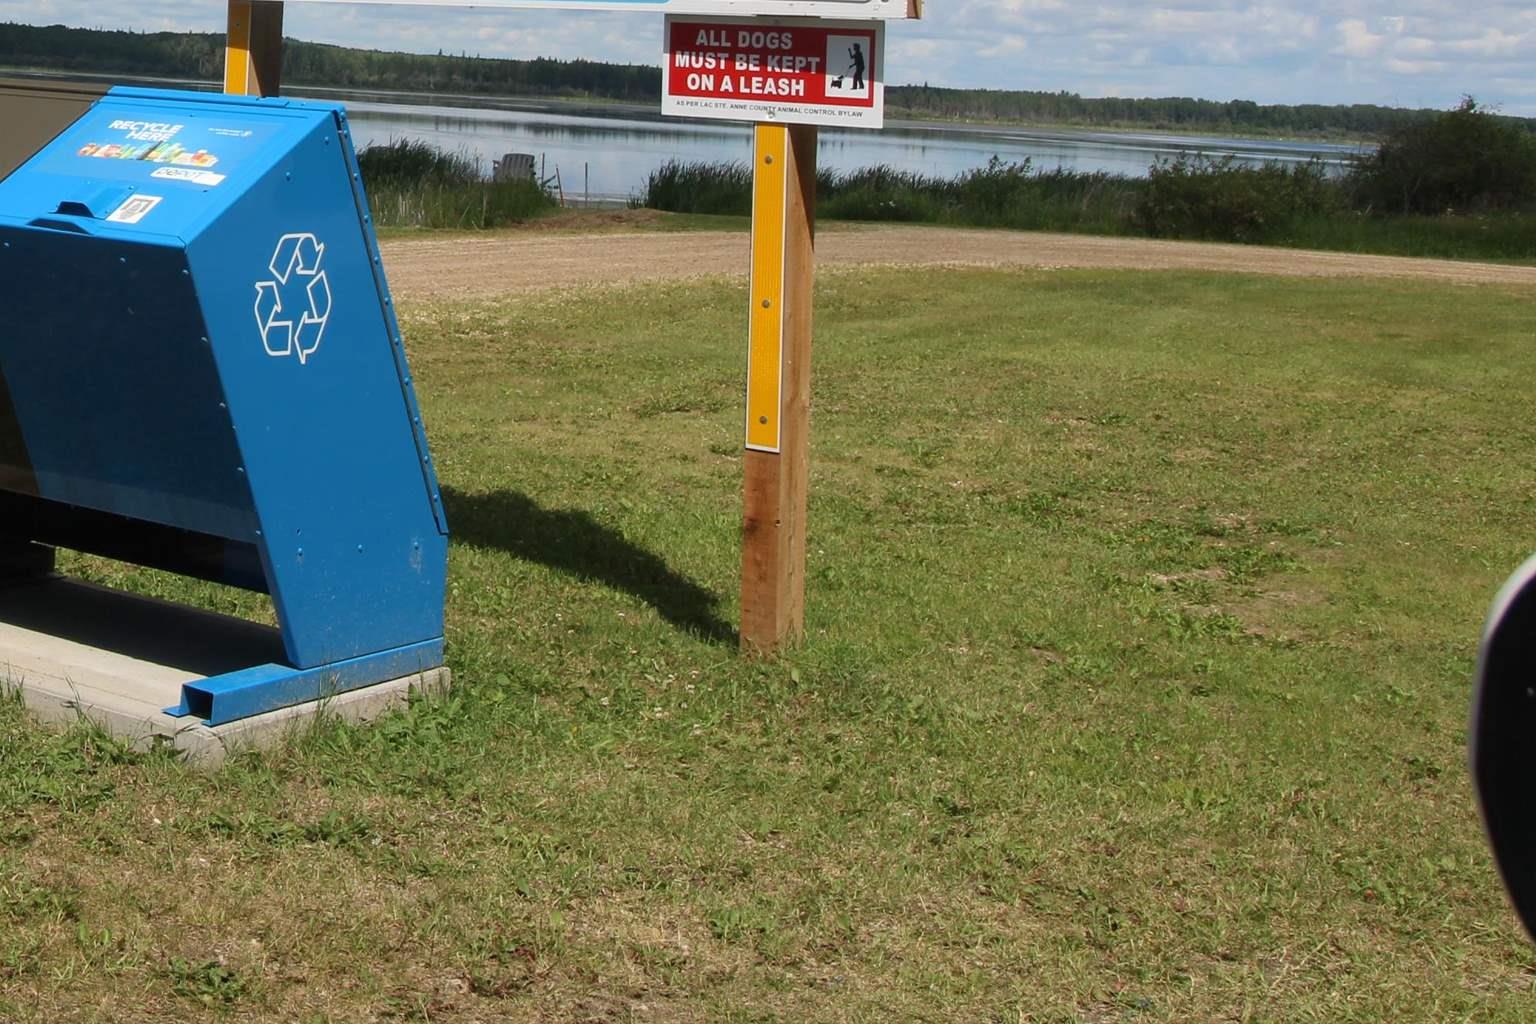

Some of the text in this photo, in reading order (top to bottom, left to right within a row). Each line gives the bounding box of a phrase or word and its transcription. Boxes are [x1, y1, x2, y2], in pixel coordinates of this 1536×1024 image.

[696, 30, 792, 49] ALL DOGS
[675, 51, 820, 74] MUST BE KEPT
[687, 74, 805, 96] ON A LEASH
[108, 120, 184, 133] RECYCLE
[126, 131, 174, 141] HERE
